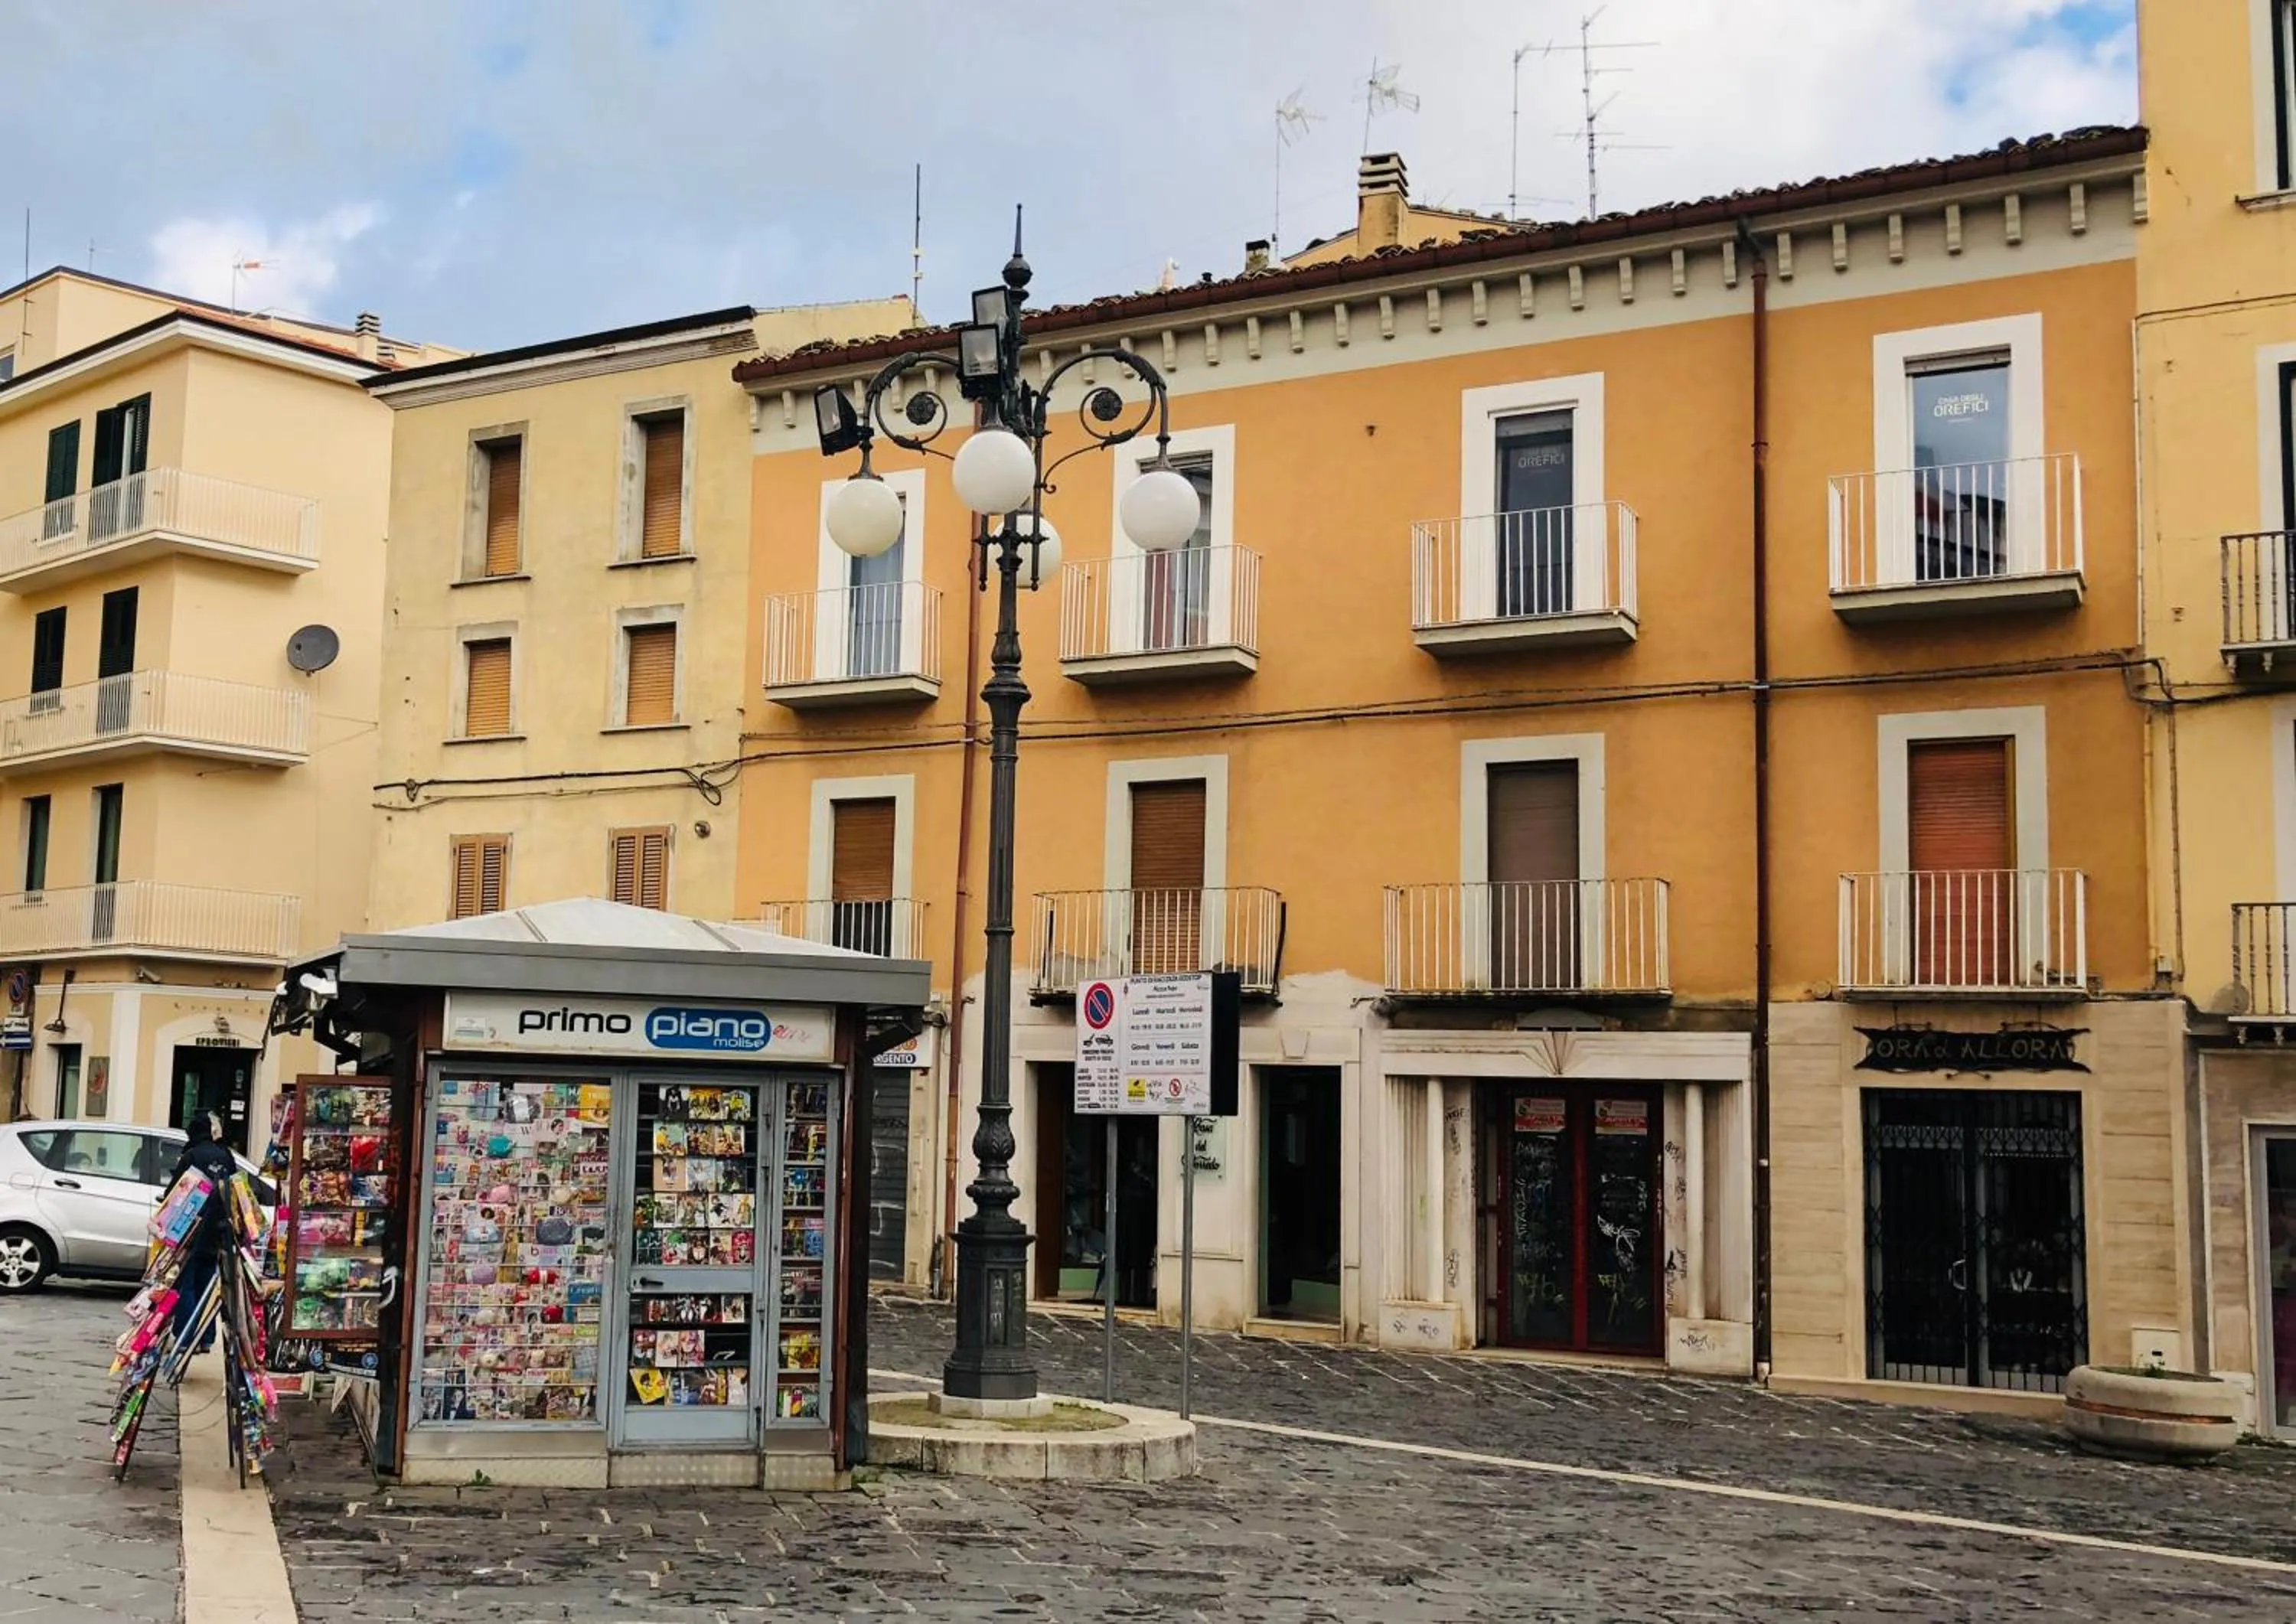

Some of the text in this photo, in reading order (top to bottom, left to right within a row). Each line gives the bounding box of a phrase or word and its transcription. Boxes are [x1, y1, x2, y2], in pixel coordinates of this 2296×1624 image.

[1934, 400, 1989, 416] OREFICI
[1518, 453, 1565, 468] OREFICI
[518, 1007, 632, 1035] primo
[651, 1012, 766, 1040] piano
[713, 1036, 765, 1048] molise
[1876, 1038, 1929, 1059] ORA
[1961, 1038, 2066, 1061] ALLORA
